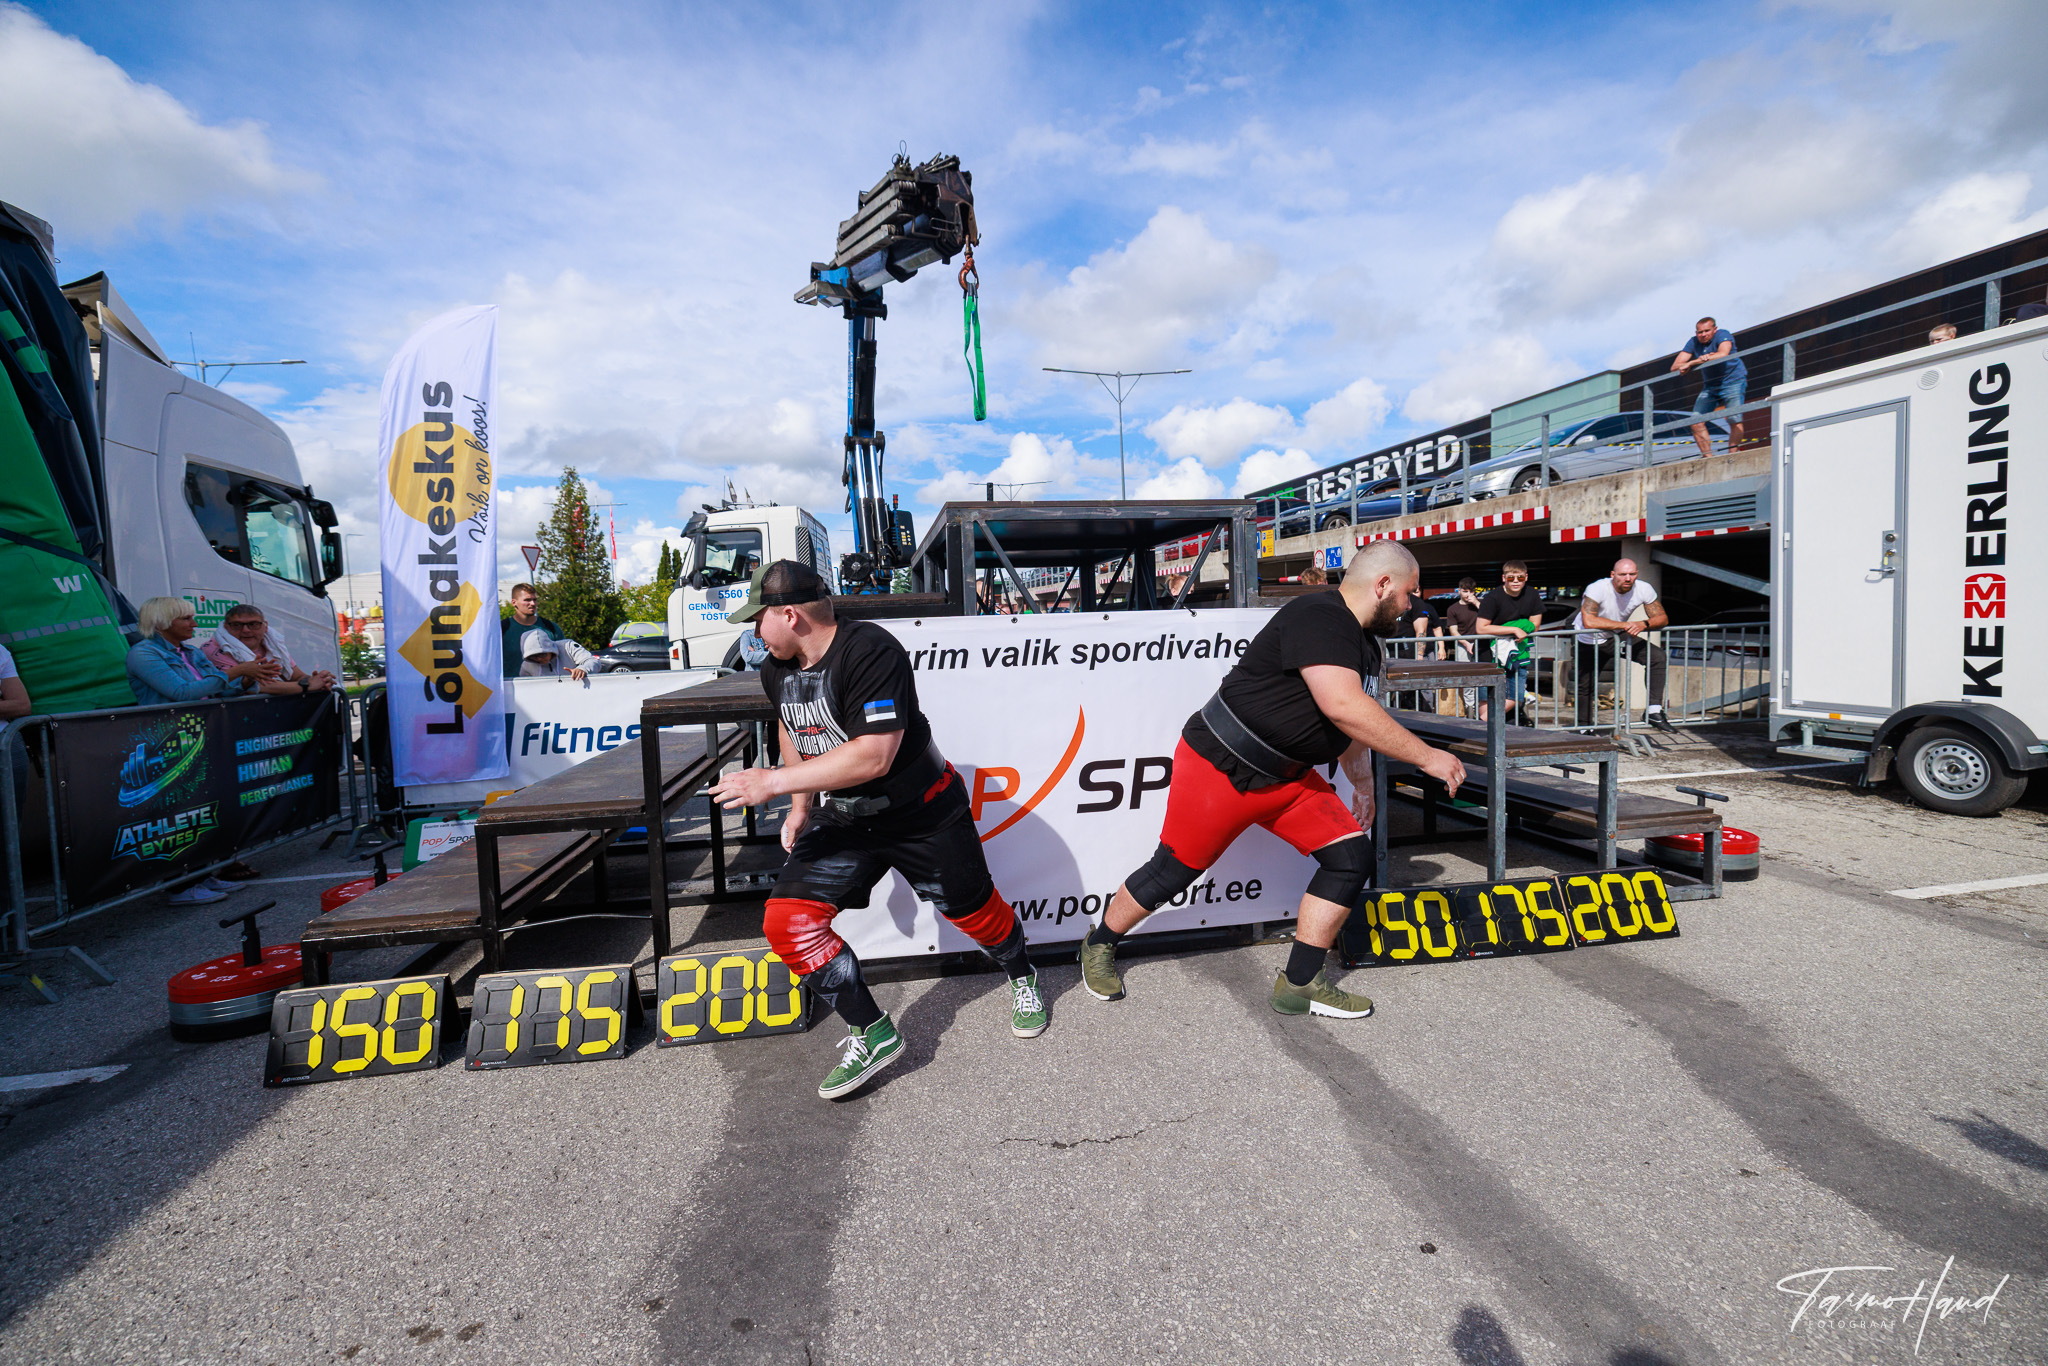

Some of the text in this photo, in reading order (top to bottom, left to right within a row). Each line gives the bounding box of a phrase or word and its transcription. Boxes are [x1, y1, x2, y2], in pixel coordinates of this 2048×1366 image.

[463, 395, 490, 543] Kõik on koos!
[1306, 434, 1461, 503] RESERVED
[414, 380, 464, 735] Lõunakeskus
[688, 602, 720, 611] GENNO
[701, 611, 735, 621] TÖSTE
[718, 589, 743, 600] 5560
[907, 632, 1250, 671] rim valik spordivahe
[236, 728, 314, 755] ENGINEERING
[238, 754, 293, 784] HUMAN
[1077, 756, 1174, 814] SP
[118, 806, 213, 852] ATHLETE
[141, 829, 194, 856] BYTES
[421, 837, 443, 847] POP
[1365, 891, 1458, 959] 150
[1478, 881, 1570, 946] 175
[1569, 871, 1676, 940] 200
[506, 971, 622, 1056] 175
[661, 951, 802, 1038] 200
[307, 981, 436, 1074] 150
